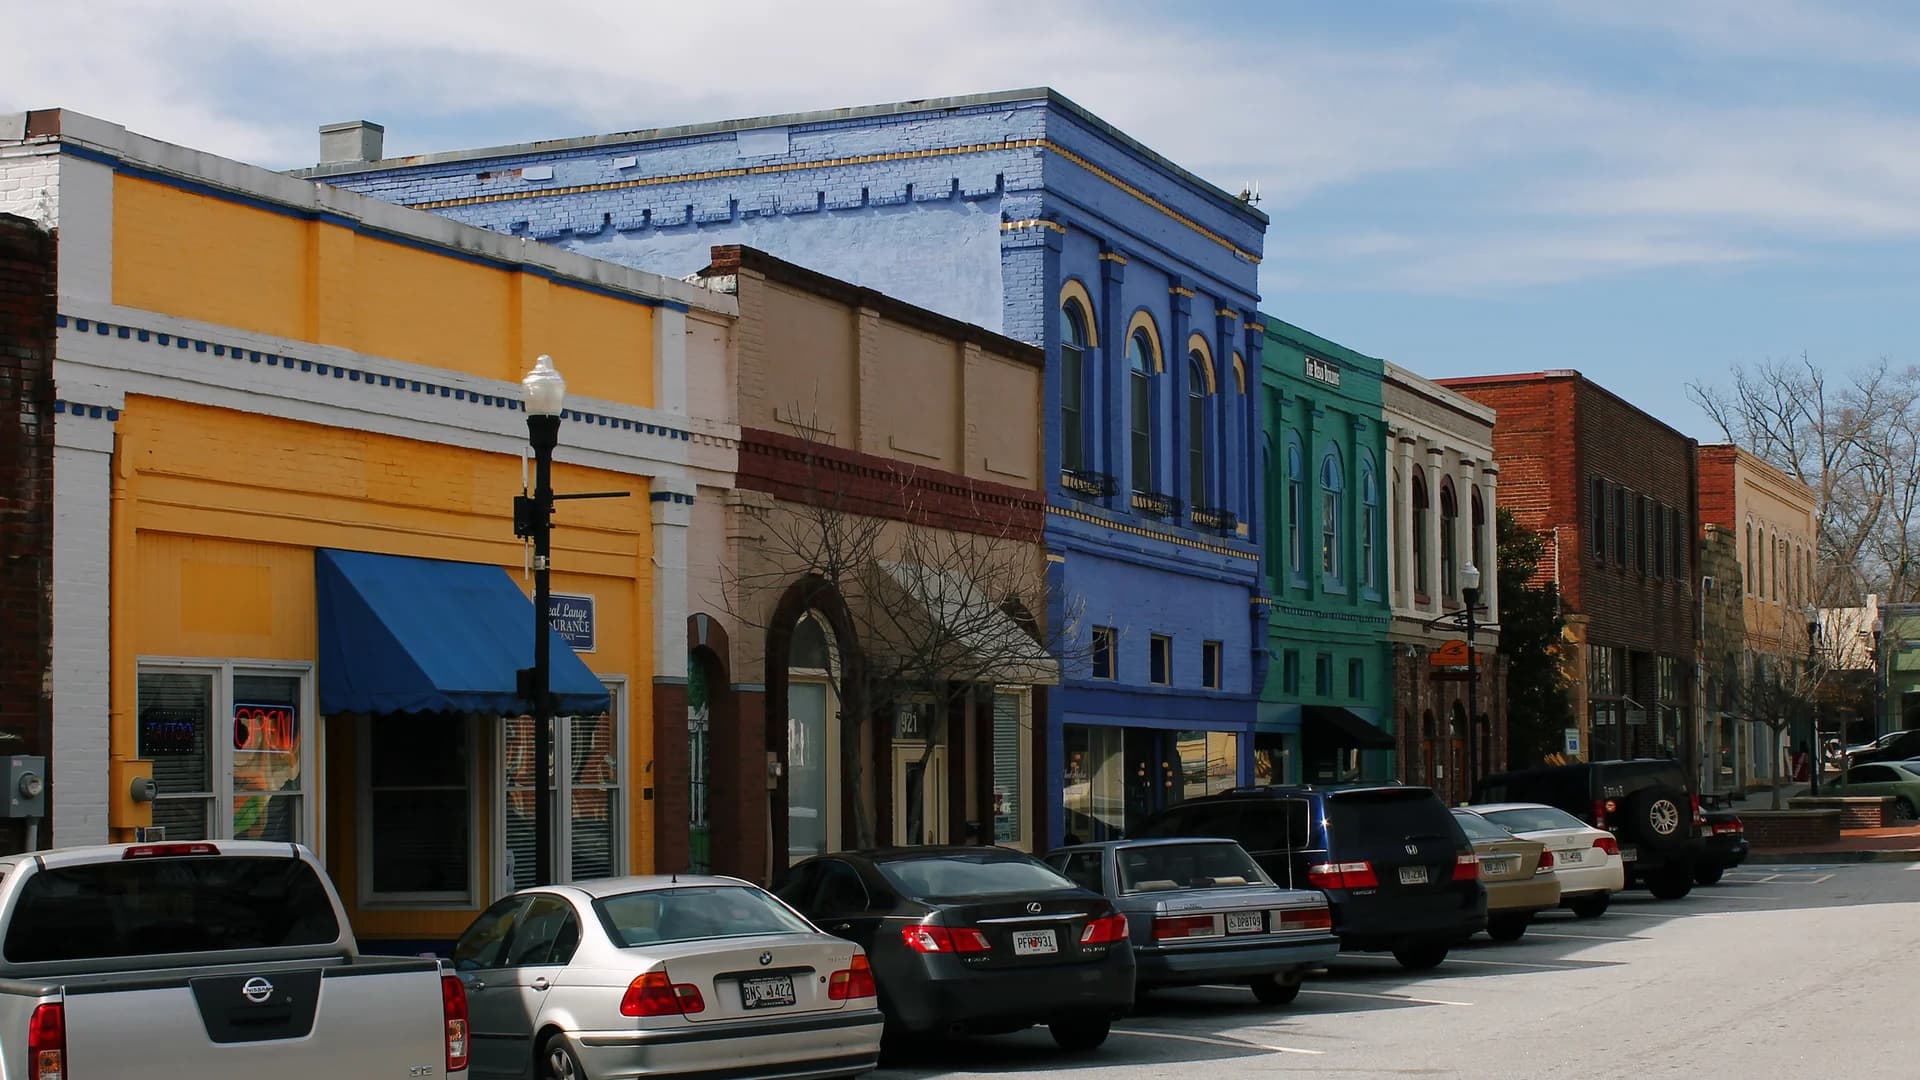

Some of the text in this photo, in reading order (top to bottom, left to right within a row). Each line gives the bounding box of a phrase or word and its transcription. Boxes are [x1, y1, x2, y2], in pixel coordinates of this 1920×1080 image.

[548, 602, 588, 620] eal Lange
[549, 618, 590, 632] URANCE
[235, 708, 291, 749] OPEN
[901, 711, 917, 733] 921
